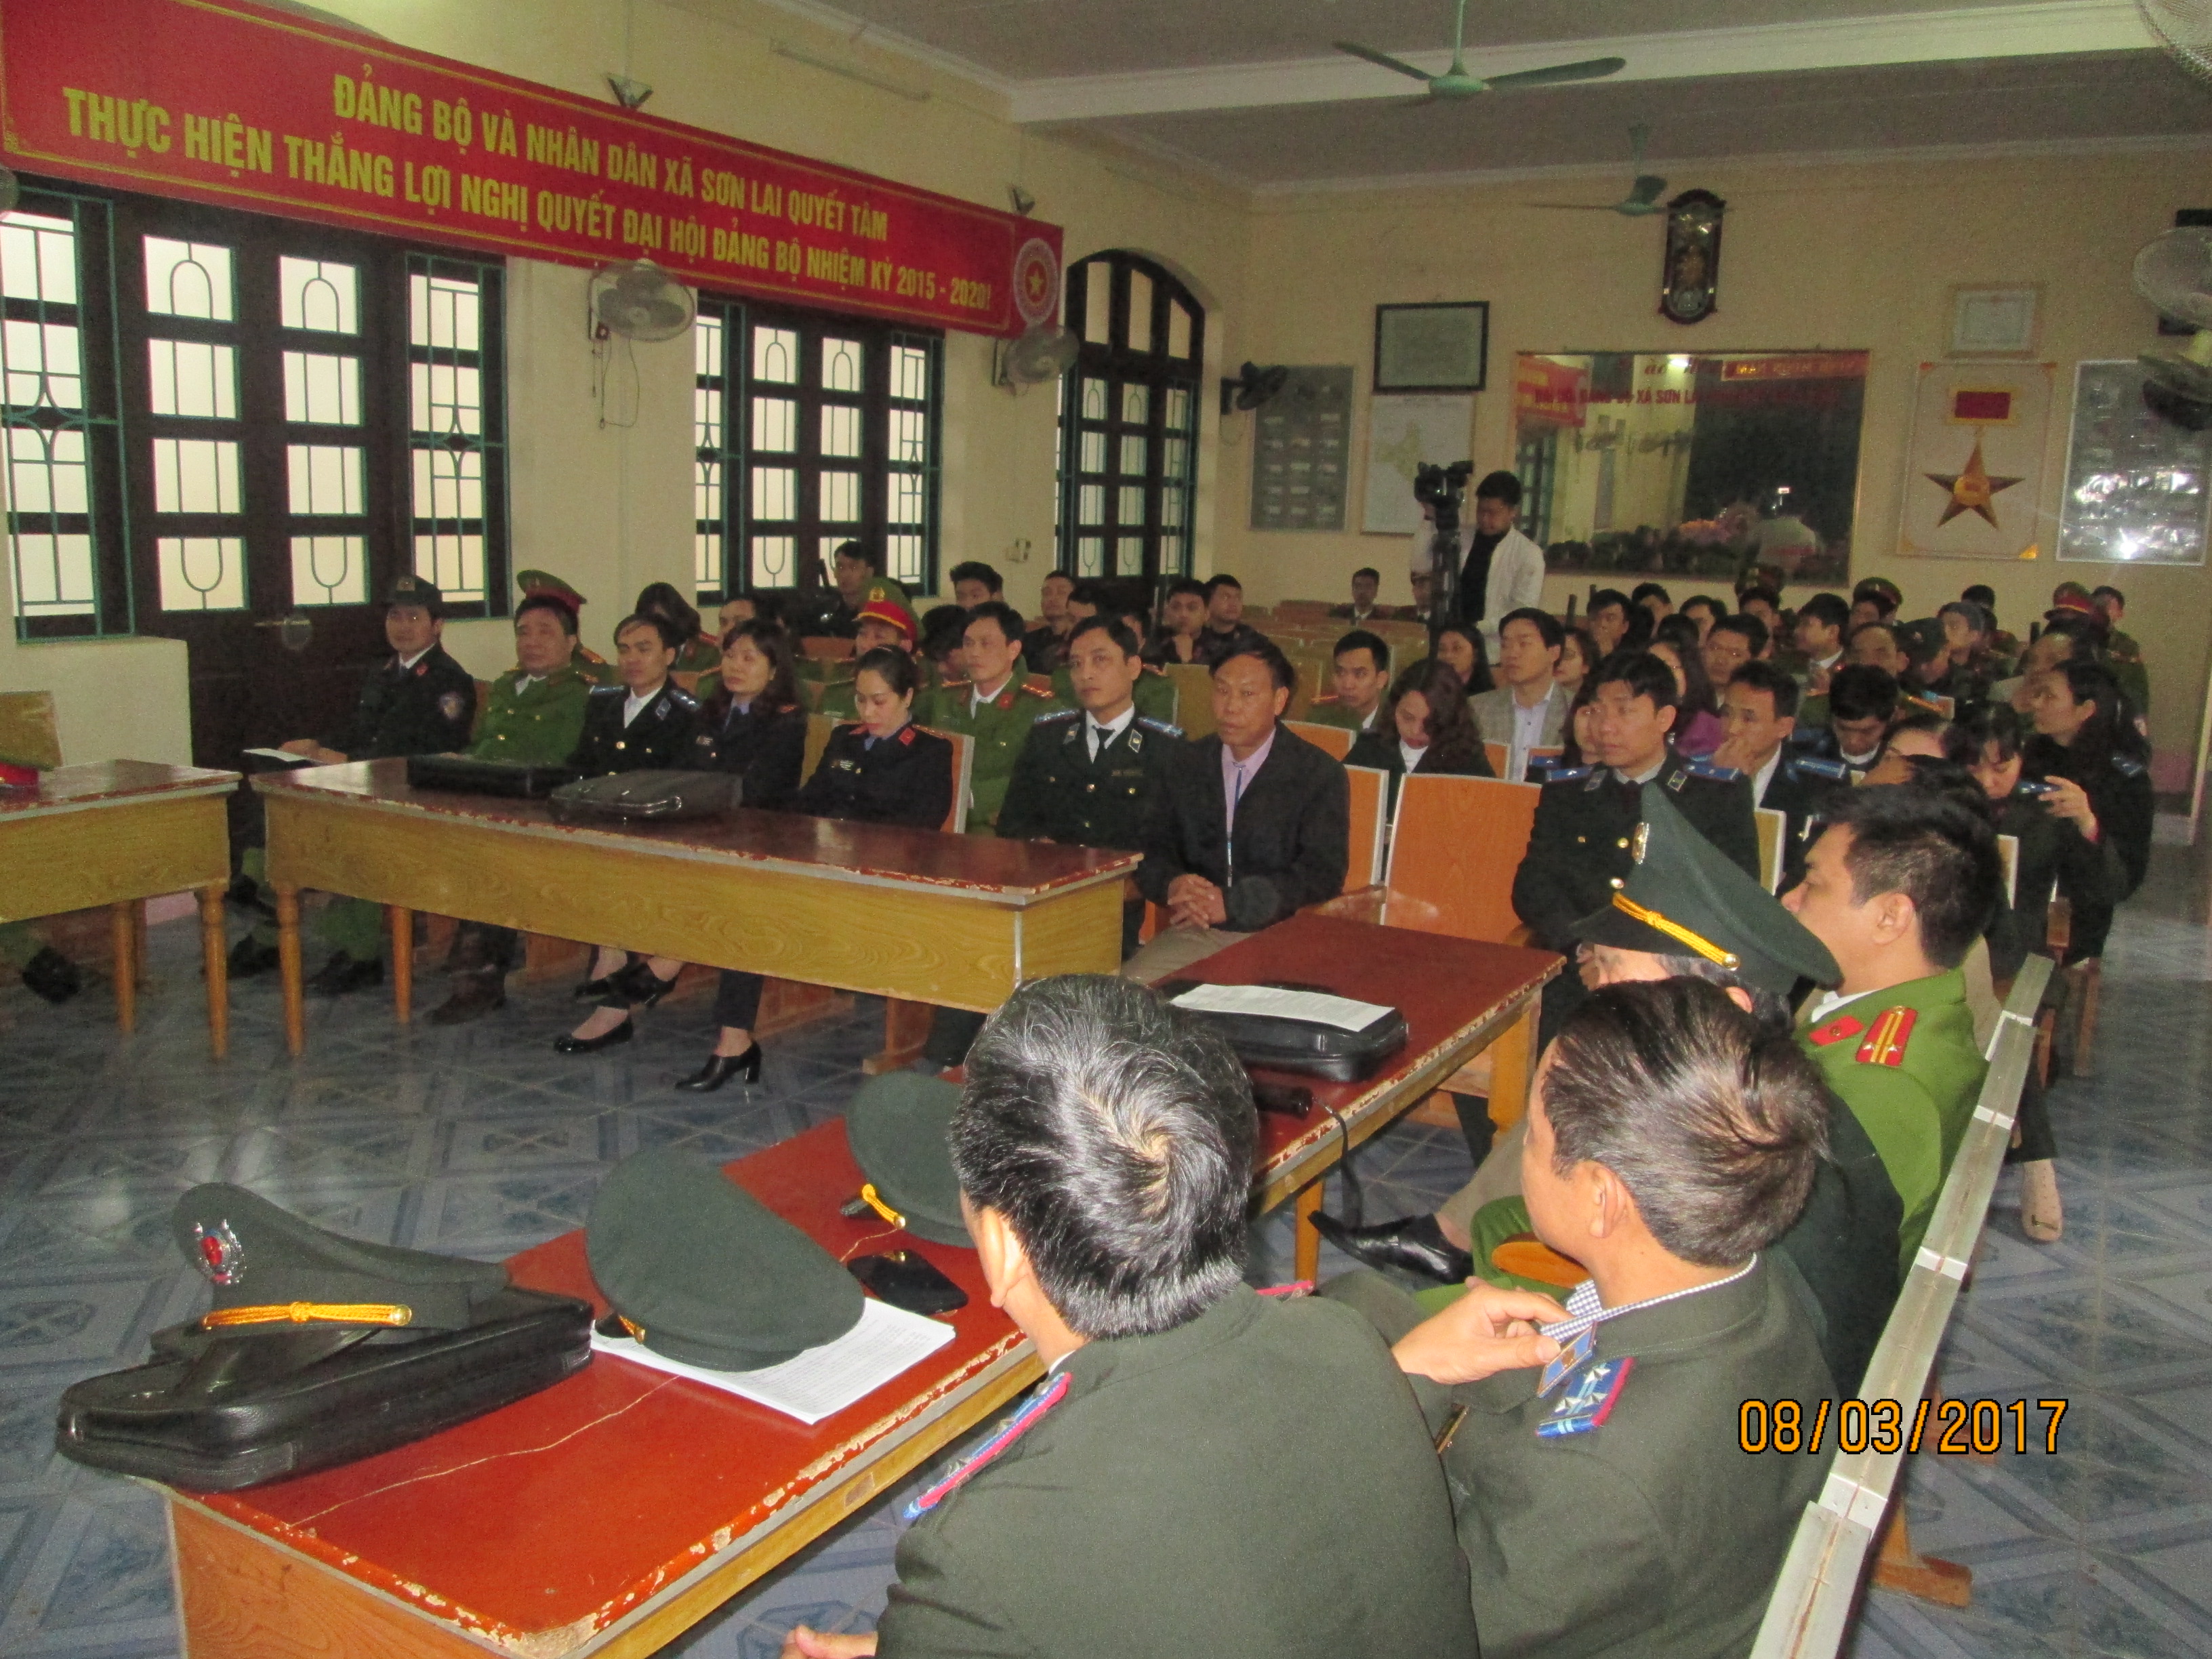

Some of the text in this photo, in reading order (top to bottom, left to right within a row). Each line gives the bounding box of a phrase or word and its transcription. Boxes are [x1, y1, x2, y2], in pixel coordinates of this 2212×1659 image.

[62, 87, 171, 159] THỰC
[184, 112, 272, 178] HIỆN
[283, 131, 394, 198] THẮNG
[405, 161, 451, 216] LỢI
[461, 173, 528, 232] NGHỊ
[537, 188, 616, 240] QUYẾT
[622, 208, 662, 255] ĐẠI
[669, 215, 706, 263] HỘI
[712, 217, 769, 270] ĐẢNG
[775, 238, 801, 282] BỘ
[806, 248, 866, 291] NHIỆM
[871, 256, 893, 291] KỲ
[897, 266, 935, 300] 2015
[333, 62, 888, 241] ĐẢNG BỘ VÀ NHÂN DÂN XÃ SƠN LAI QUYẾT TÂM
